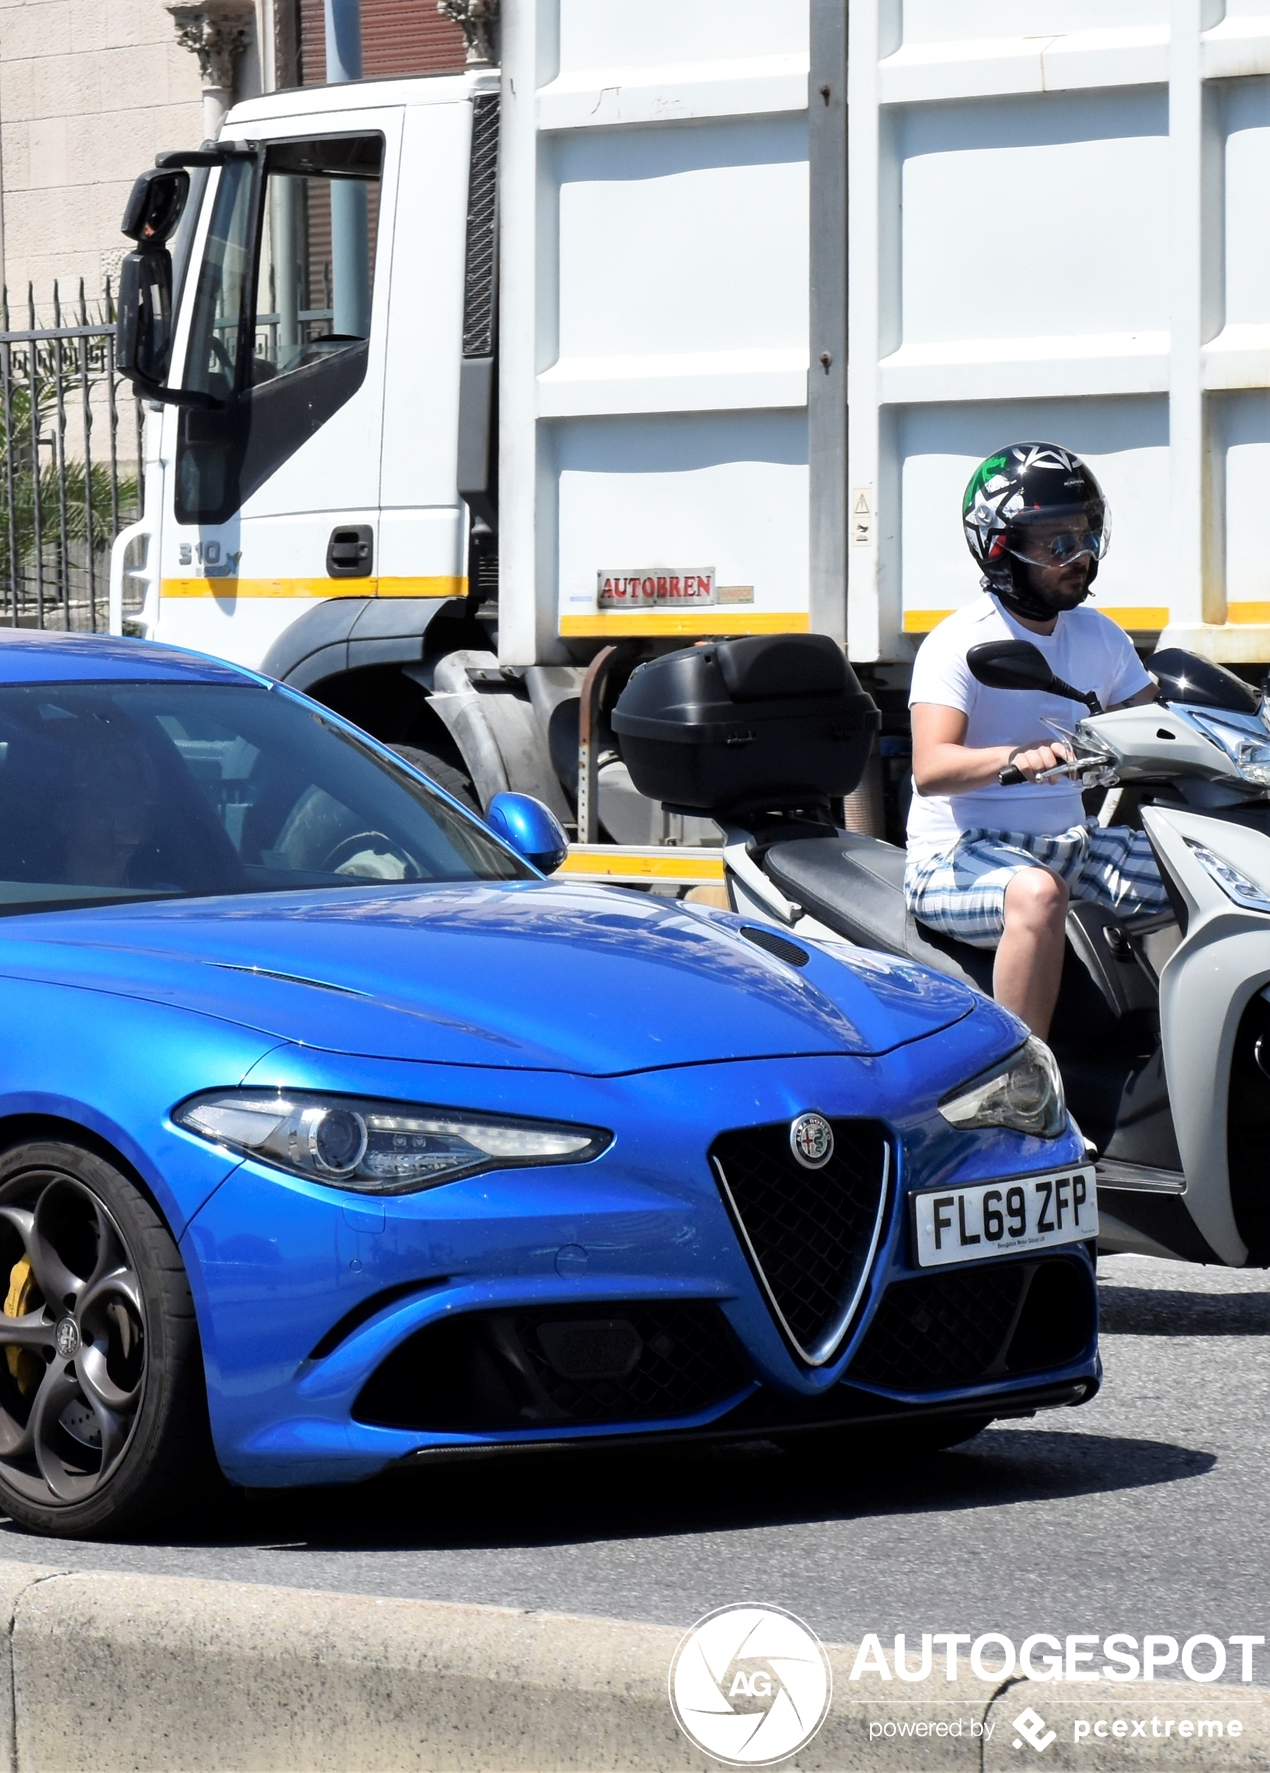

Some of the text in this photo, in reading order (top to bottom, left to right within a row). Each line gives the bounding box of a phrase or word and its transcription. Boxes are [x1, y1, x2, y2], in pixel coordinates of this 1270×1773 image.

[178, 541, 221, 566] 310
[600, 575, 712, 599] AUTOBREN
[809, 1118, 832, 1141] ROMEO
[933, 1174, 1087, 1250] FL69 ZFP
